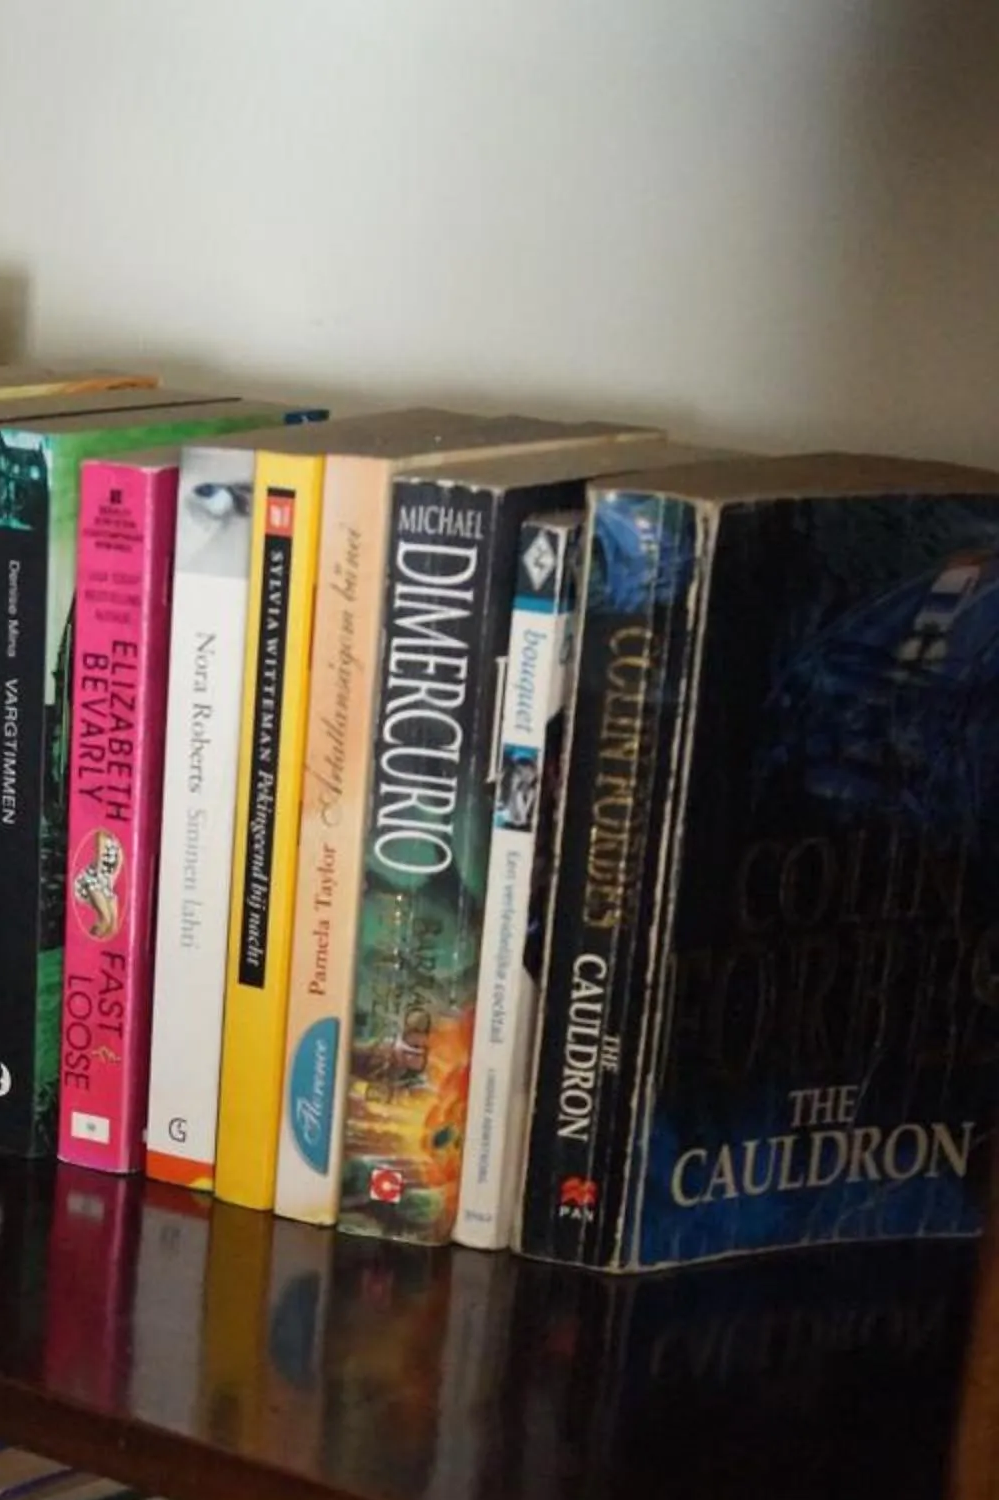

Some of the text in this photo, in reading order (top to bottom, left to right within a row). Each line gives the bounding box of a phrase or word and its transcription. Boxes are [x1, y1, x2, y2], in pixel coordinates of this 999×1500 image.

[400, 506, 483, 539] MICHAEL
[265, 551, 284, 631] SYLVIA
[1, 560, 20, 825] Denise Mina VARGTIMMEN
[192, 632, 216, 695] Nora
[258, 638, 280, 764] WITTEMAN
[374, 541, 479, 875] DIMERCURIO
[514, 629, 546, 733] bouquet
[77, 653, 108, 806] BEVARLY
[106, 639, 138, 822] ELIZABETH
[187, 703, 213, 794] Roberts
[250, 877, 268, 912] bij
[307, 843, 338, 996] Pamela Taylor
[245, 914, 265, 966] nacht
[64, 975, 94, 1091] LOOSE
[97, 950, 126, 1038] FAST
[557, 953, 608, 1142] CAULDRON
[602, 1034, 620, 1073] THE
[787, 1084, 862, 1131] THE
[671, 1121, 974, 1207] CAULDRON
[559, 1206, 593, 1222] PAN
